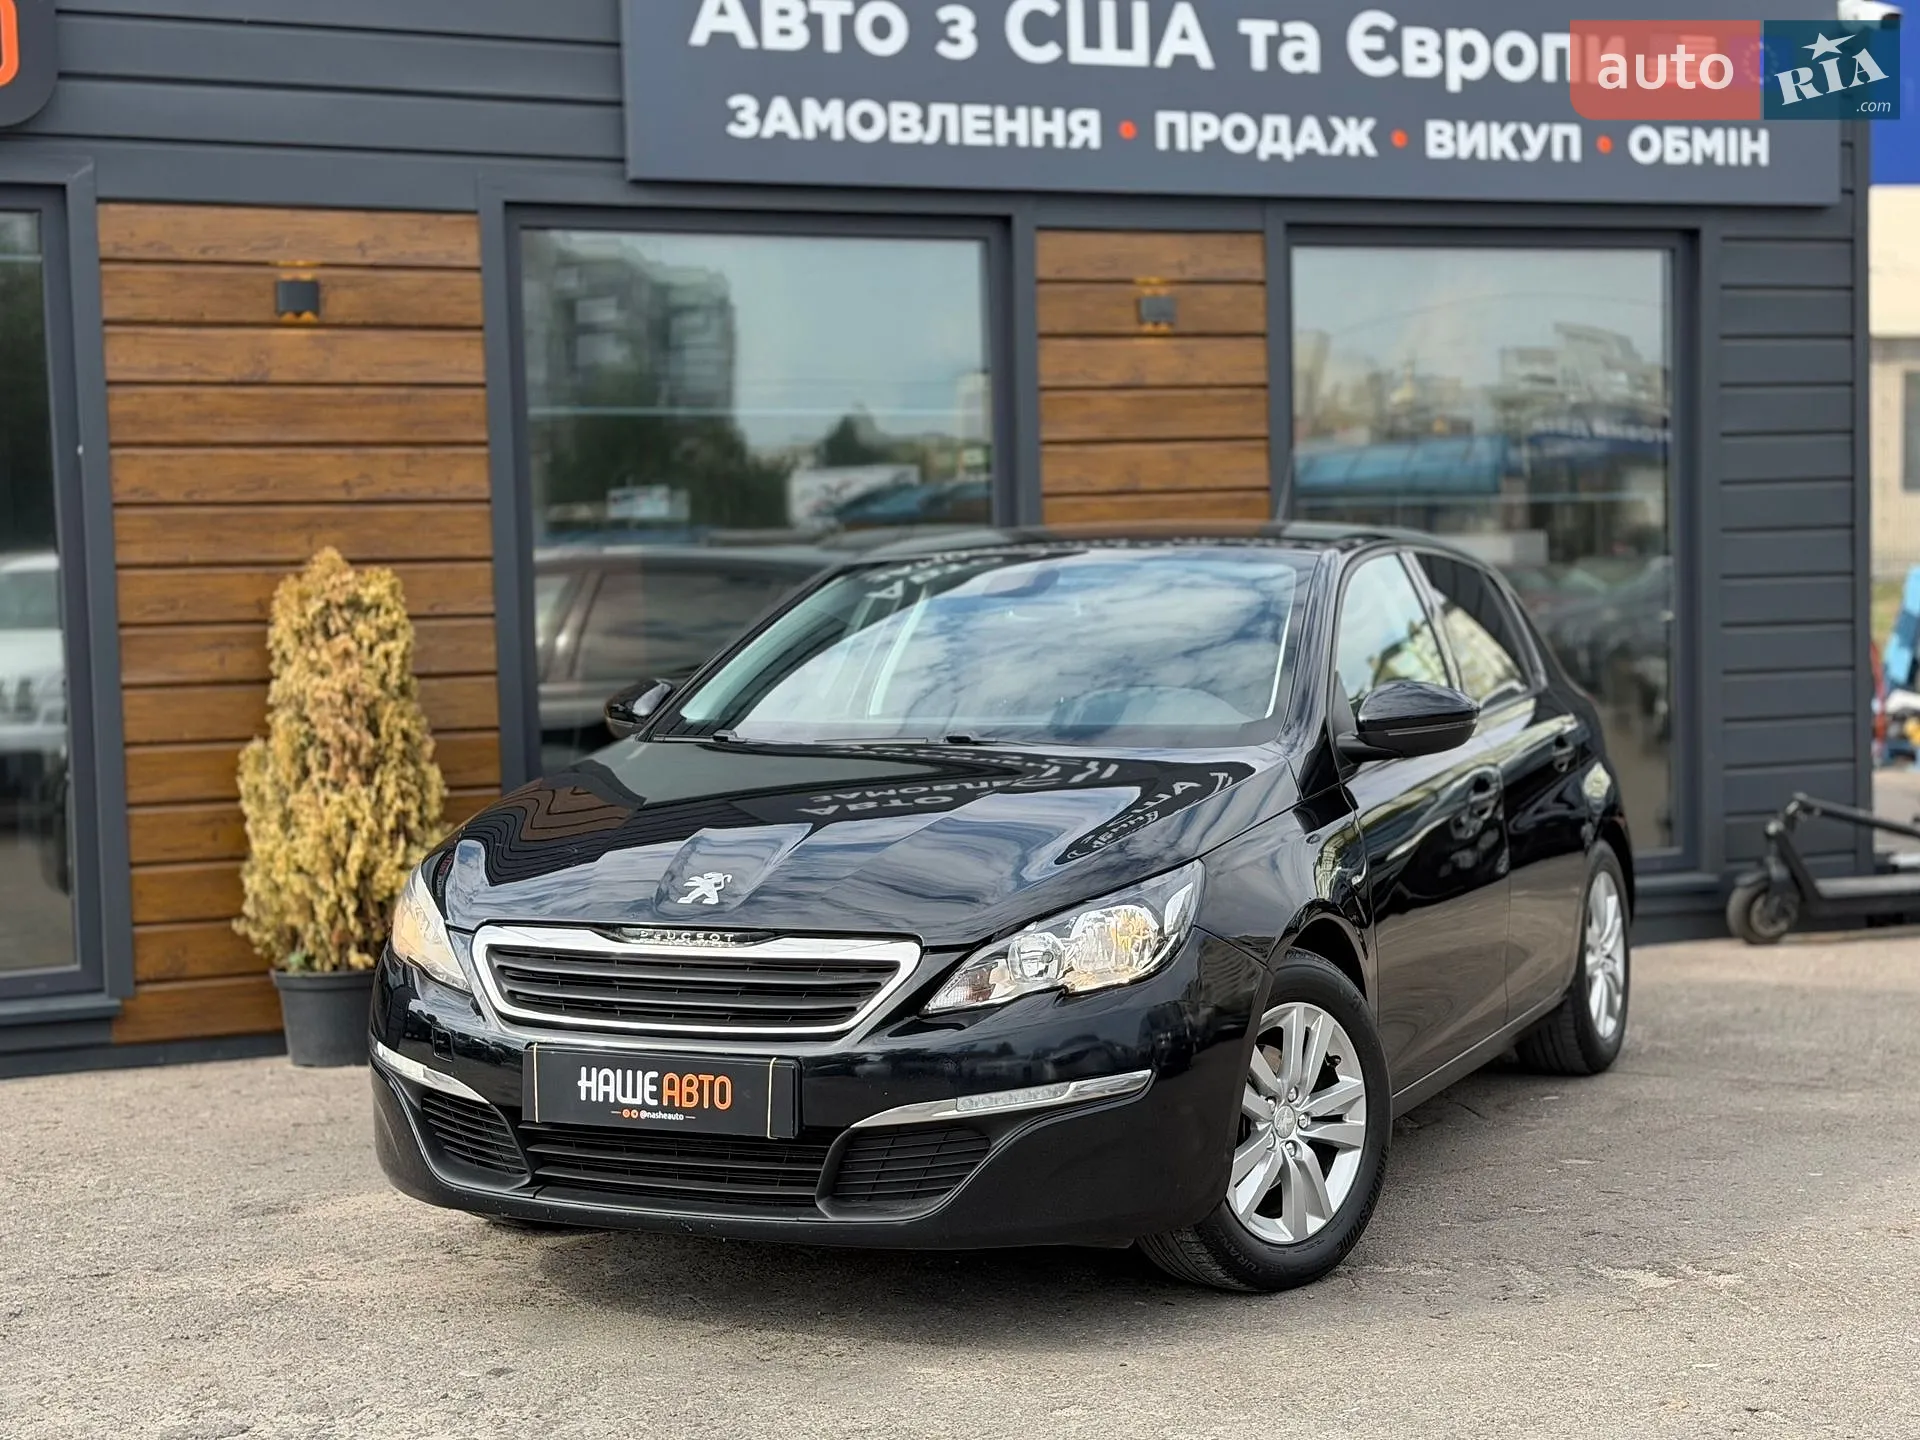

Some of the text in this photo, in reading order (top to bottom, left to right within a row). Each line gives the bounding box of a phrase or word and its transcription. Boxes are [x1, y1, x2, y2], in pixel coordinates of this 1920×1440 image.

[1004, 0, 1216, 70] США
[1237, 18, 1322, 74] та
[726, 93, 1770, 167] ЗАМОВЛЕННЯ ПРОДАЖ ВИКУП ОБМІН
[576, 1066, 733, 1111] НАШЕ АВТО
[639, 1109, 685, 1121] @nasheauto
